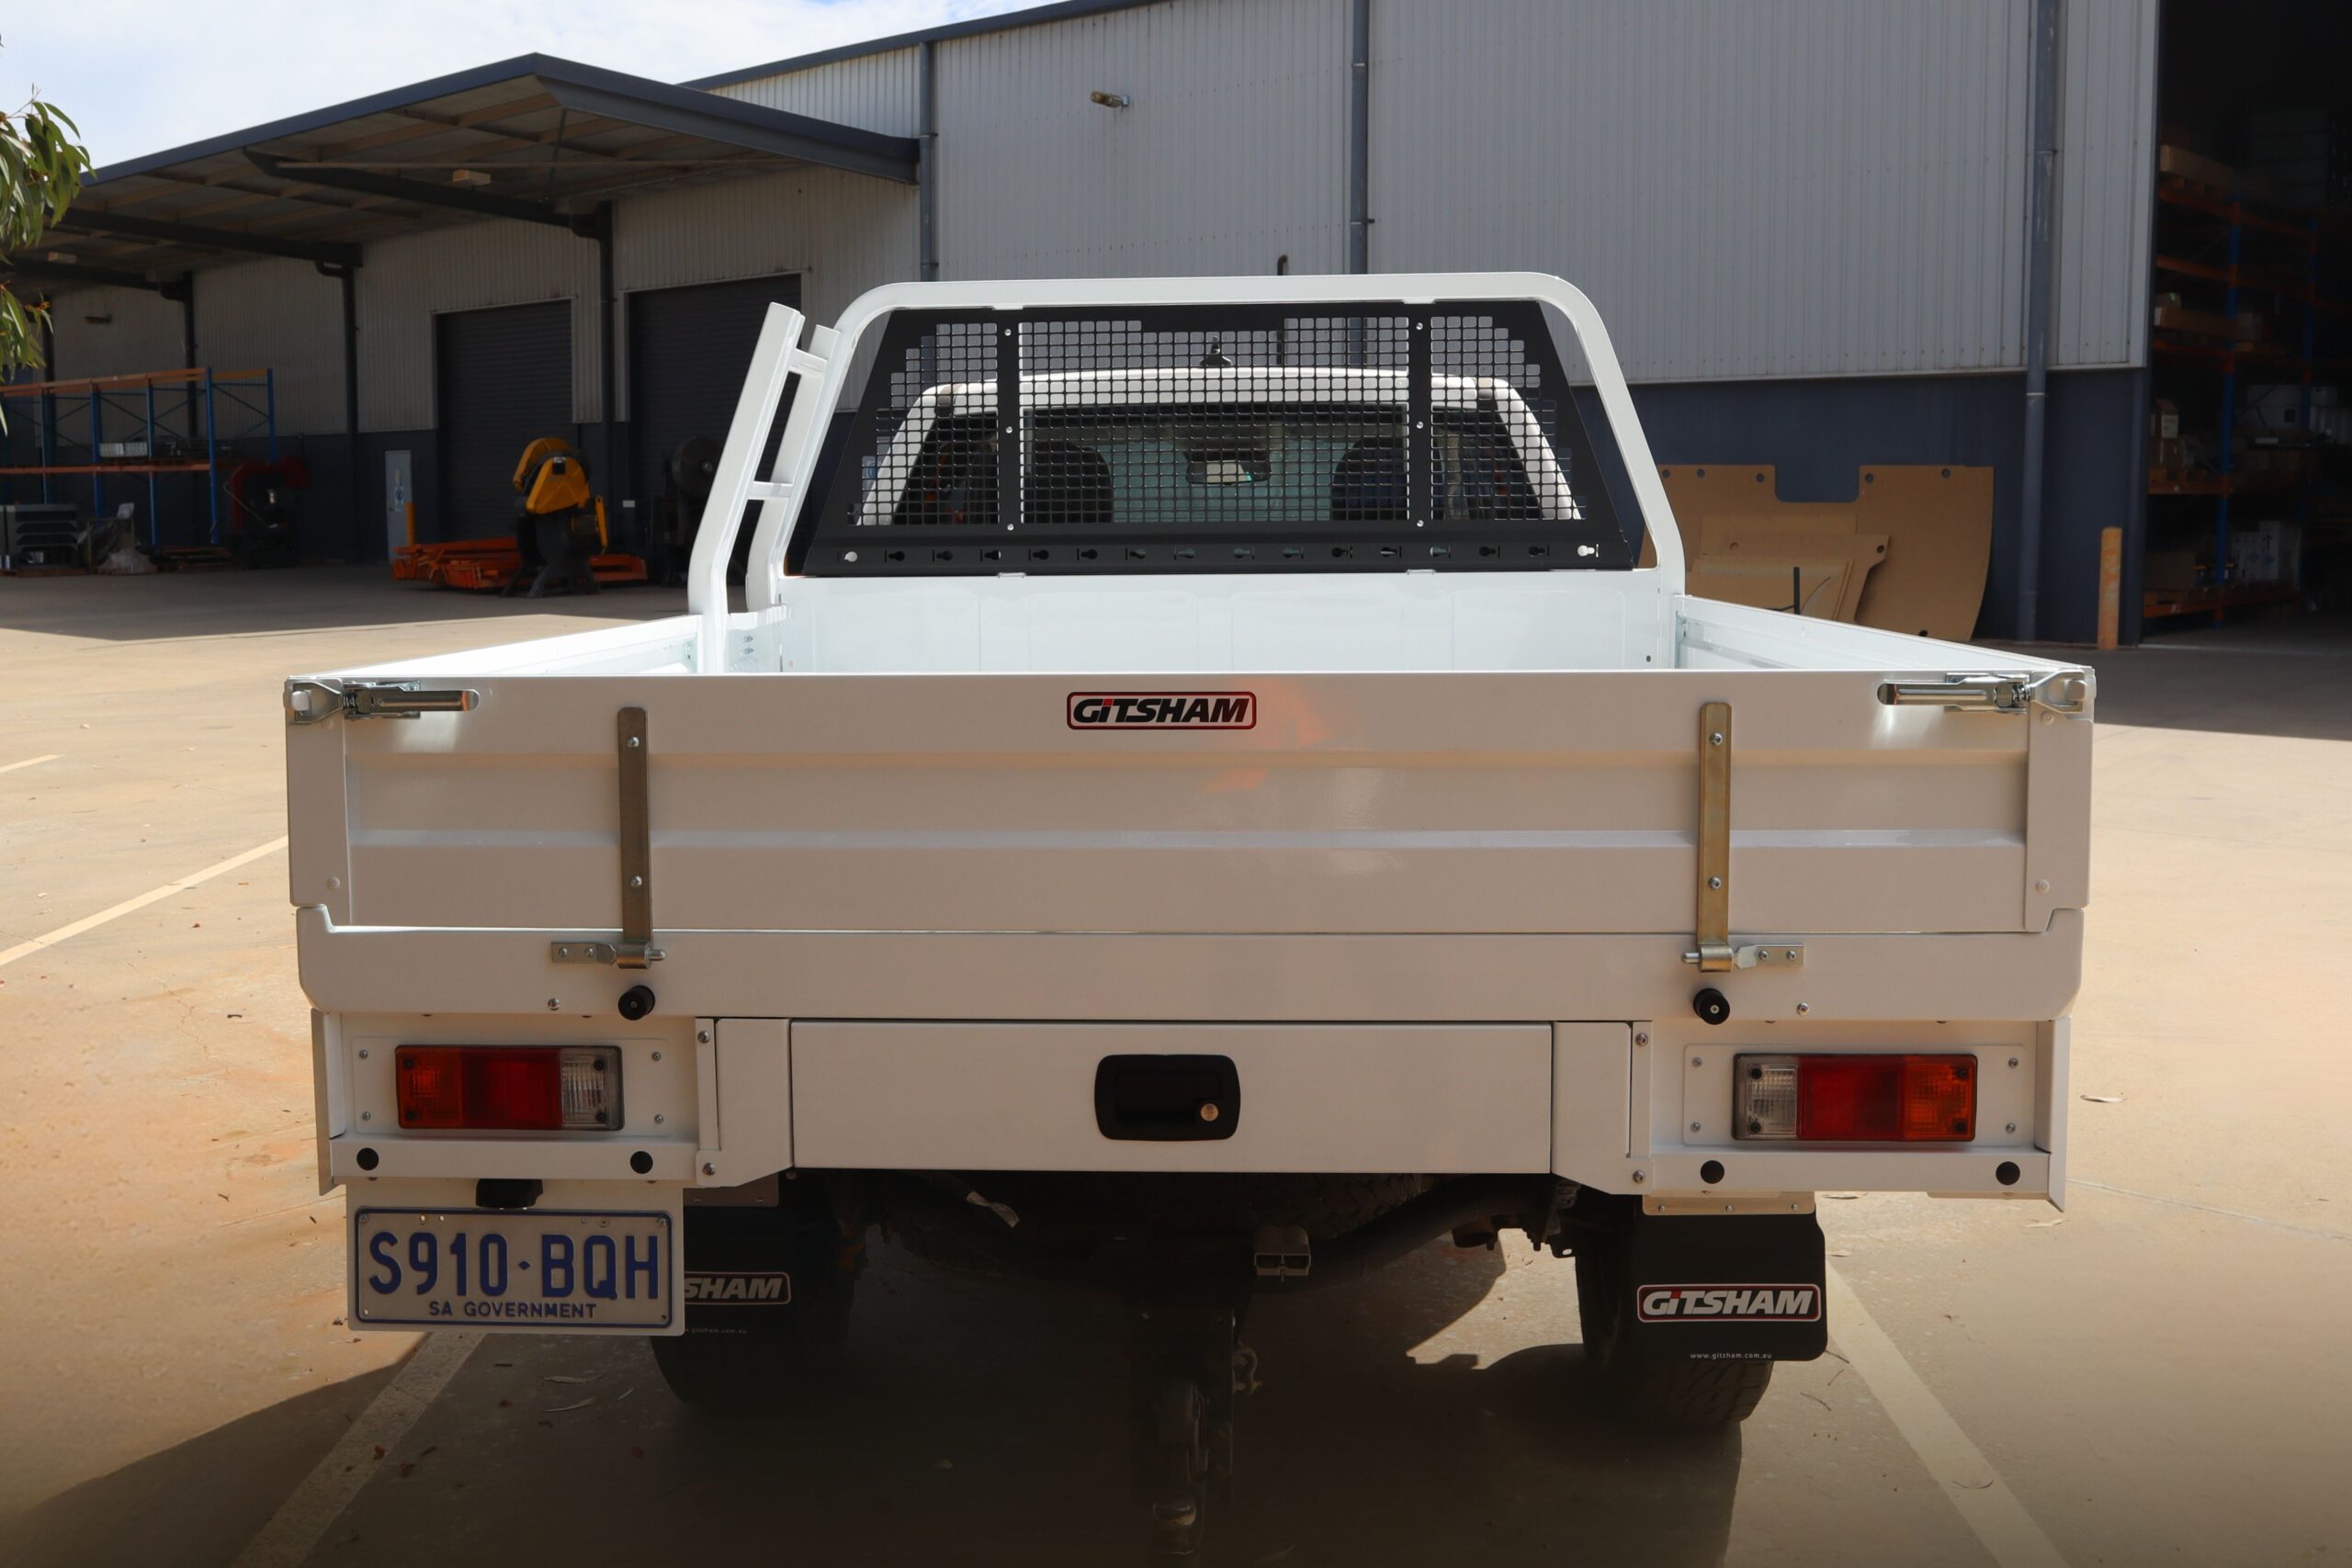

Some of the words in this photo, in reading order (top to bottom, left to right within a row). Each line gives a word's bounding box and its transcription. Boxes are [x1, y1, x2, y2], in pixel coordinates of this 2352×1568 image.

[684, 1278, 783, 1299] SHAM
[428, 1301, 453, 1316] SA
[464, 1301, 597, 1318] GOVERNMENT
[1690, 1351, 1772, 1360] www.gitsham.com.au
